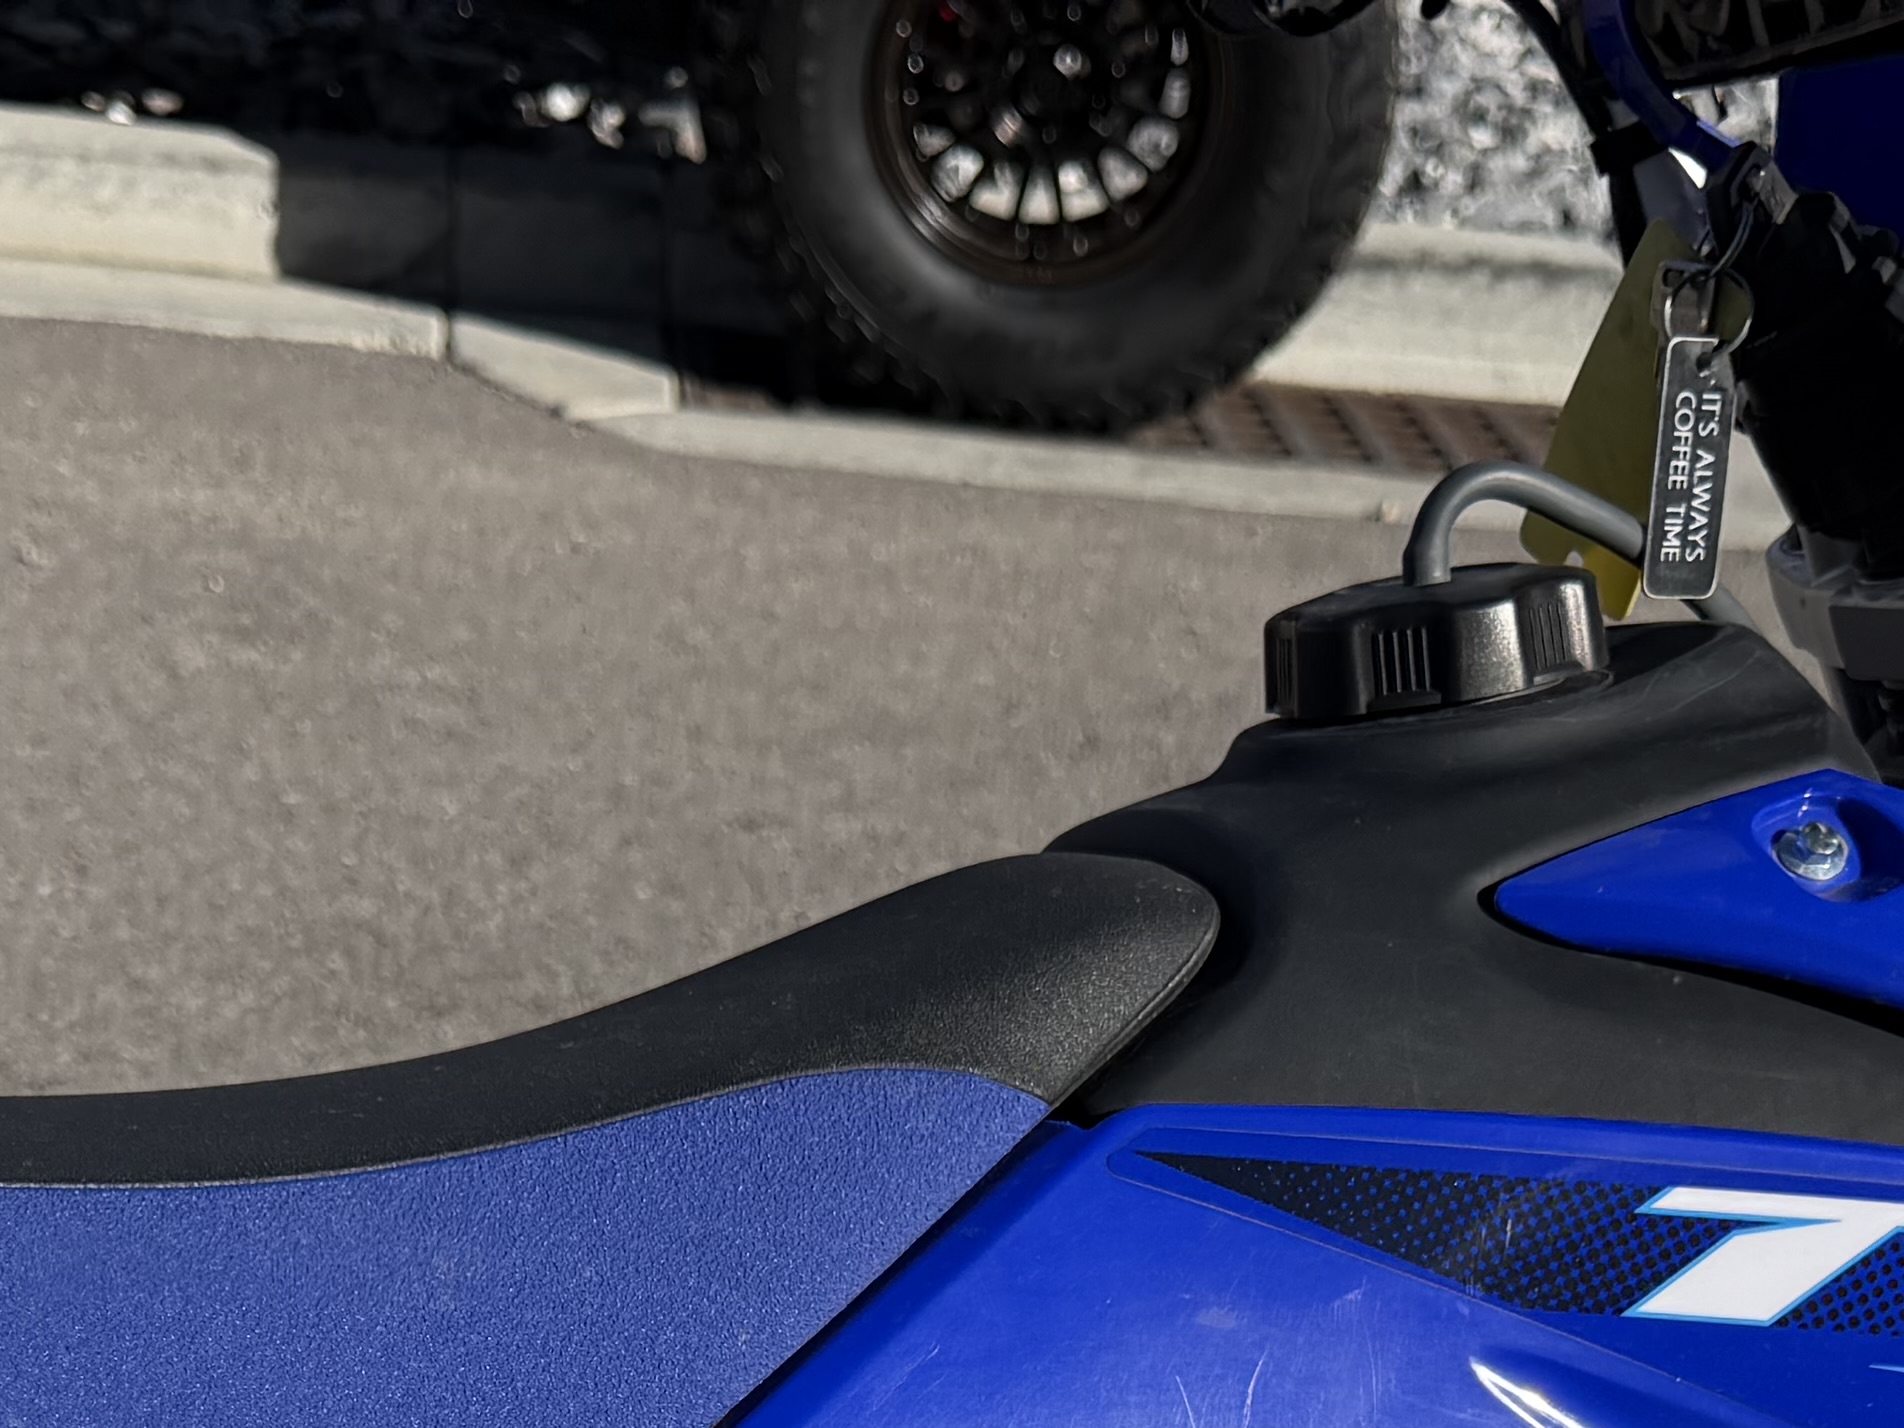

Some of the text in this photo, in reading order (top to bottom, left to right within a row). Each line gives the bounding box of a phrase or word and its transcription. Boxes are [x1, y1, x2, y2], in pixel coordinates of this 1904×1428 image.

[1660, 391, 1696, 562] COFFEE TIME
[1685, 392, 1723, 562] IT'S ALWAYS
